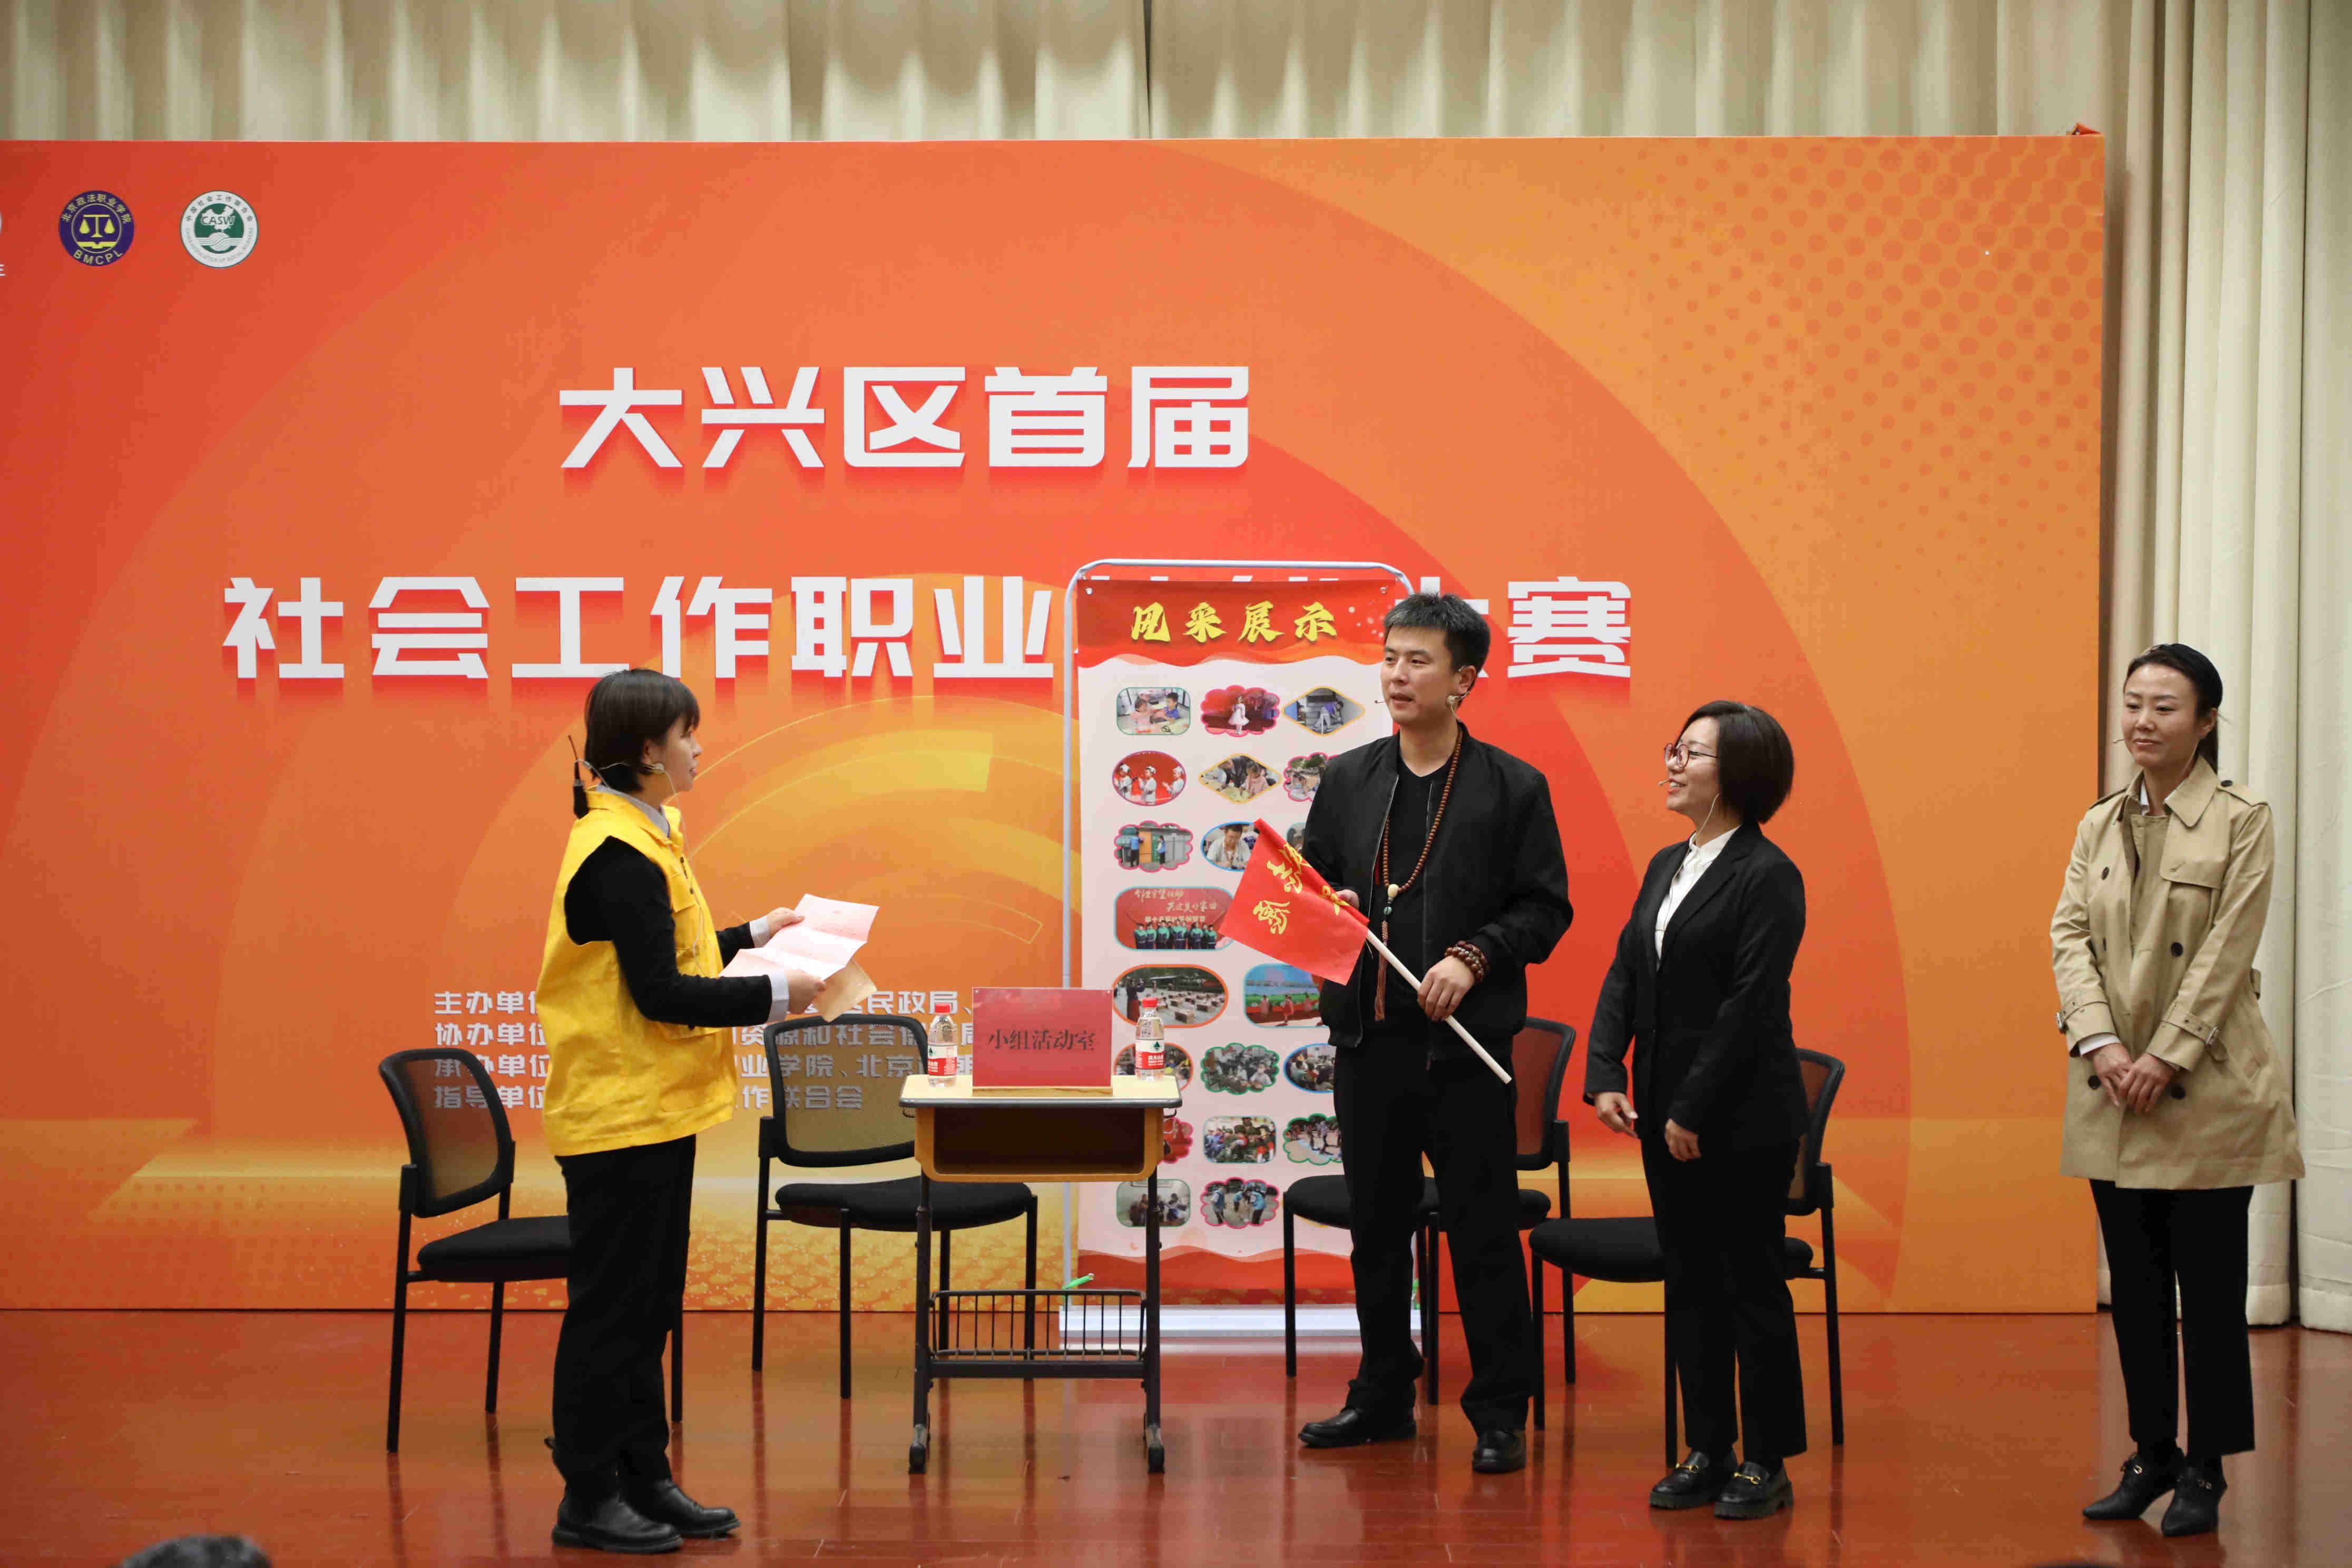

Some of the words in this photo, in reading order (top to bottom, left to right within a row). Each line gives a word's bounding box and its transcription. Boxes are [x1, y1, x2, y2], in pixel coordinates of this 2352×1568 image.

[201, 214, 236, 226] CASW
[73, 249, 122, 265] BMCPL
[559, 366, 1249, 468] 大兴区首届
[1130, 600, 1338, 644] 风采展示
[435, 1022, 548, 1046] 协办单位
[987, 1029, 1096, 1050] 小组活动室
